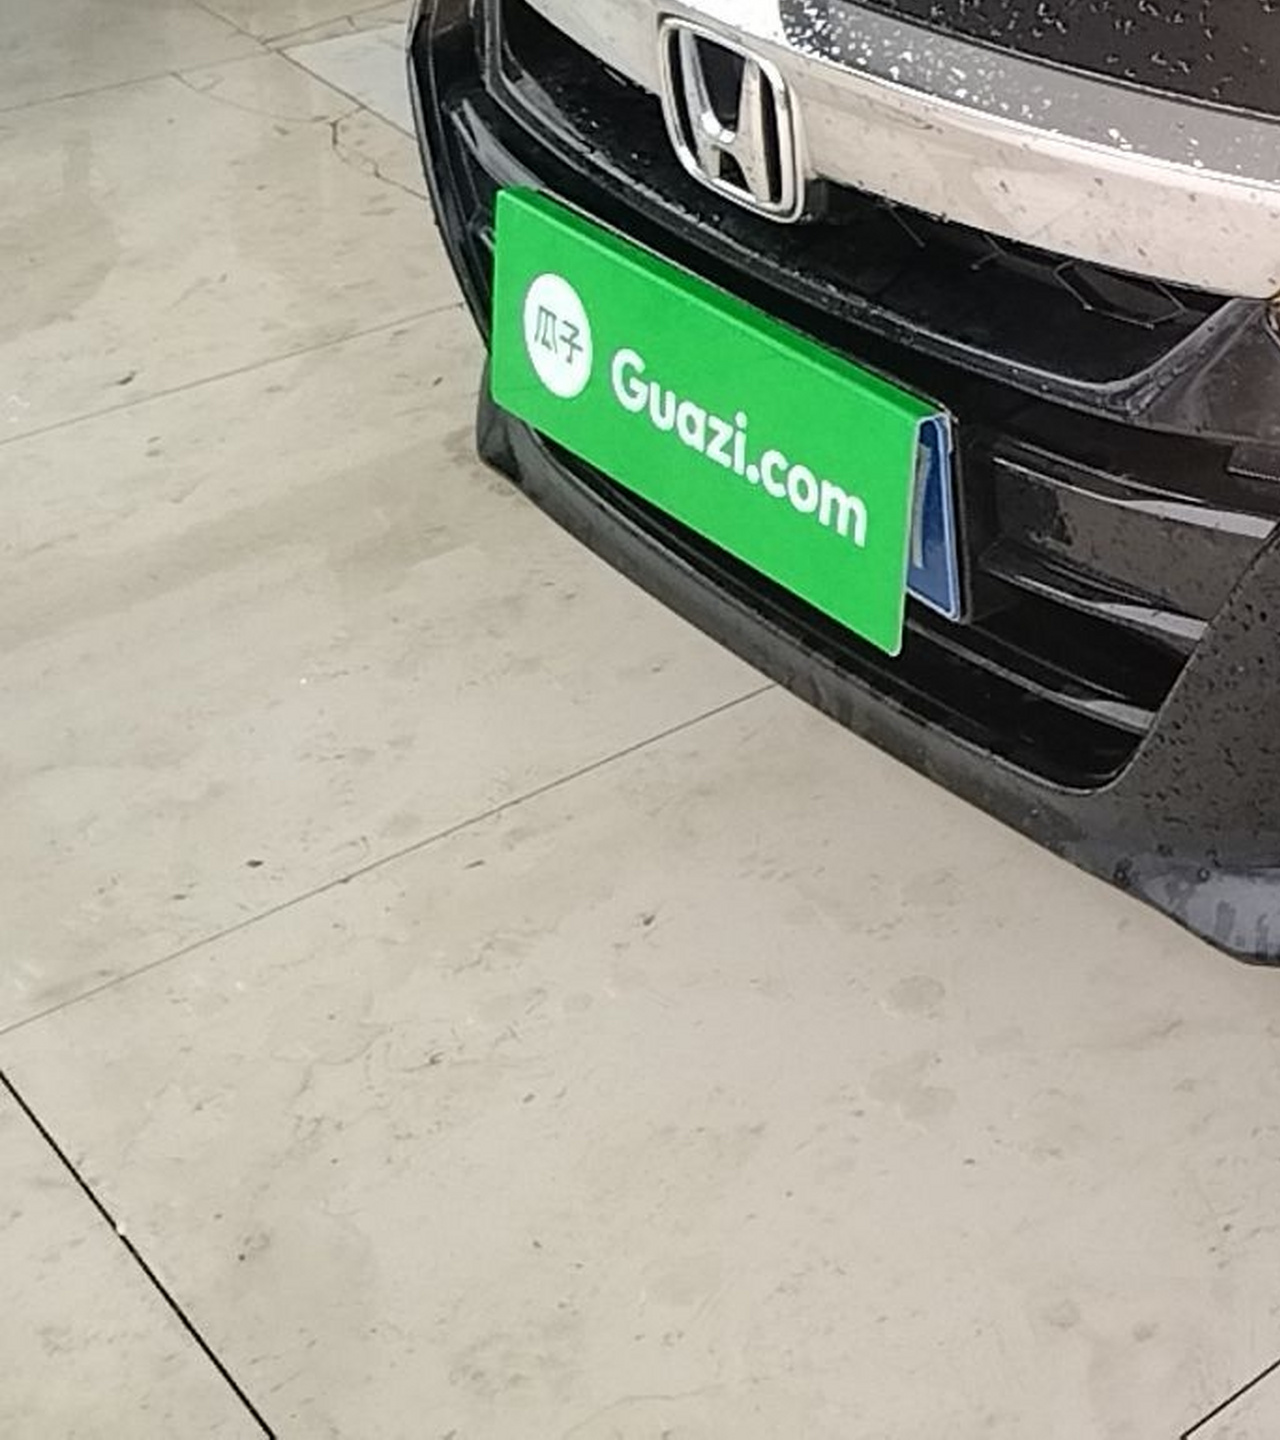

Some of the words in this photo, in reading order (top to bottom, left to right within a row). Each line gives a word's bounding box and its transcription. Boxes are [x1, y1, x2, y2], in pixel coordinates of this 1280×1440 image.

[677, 27, 772, 204] H
[534, 305, 584, 364] 瓜子
[611, 347, 868, 549] Guazi.com
